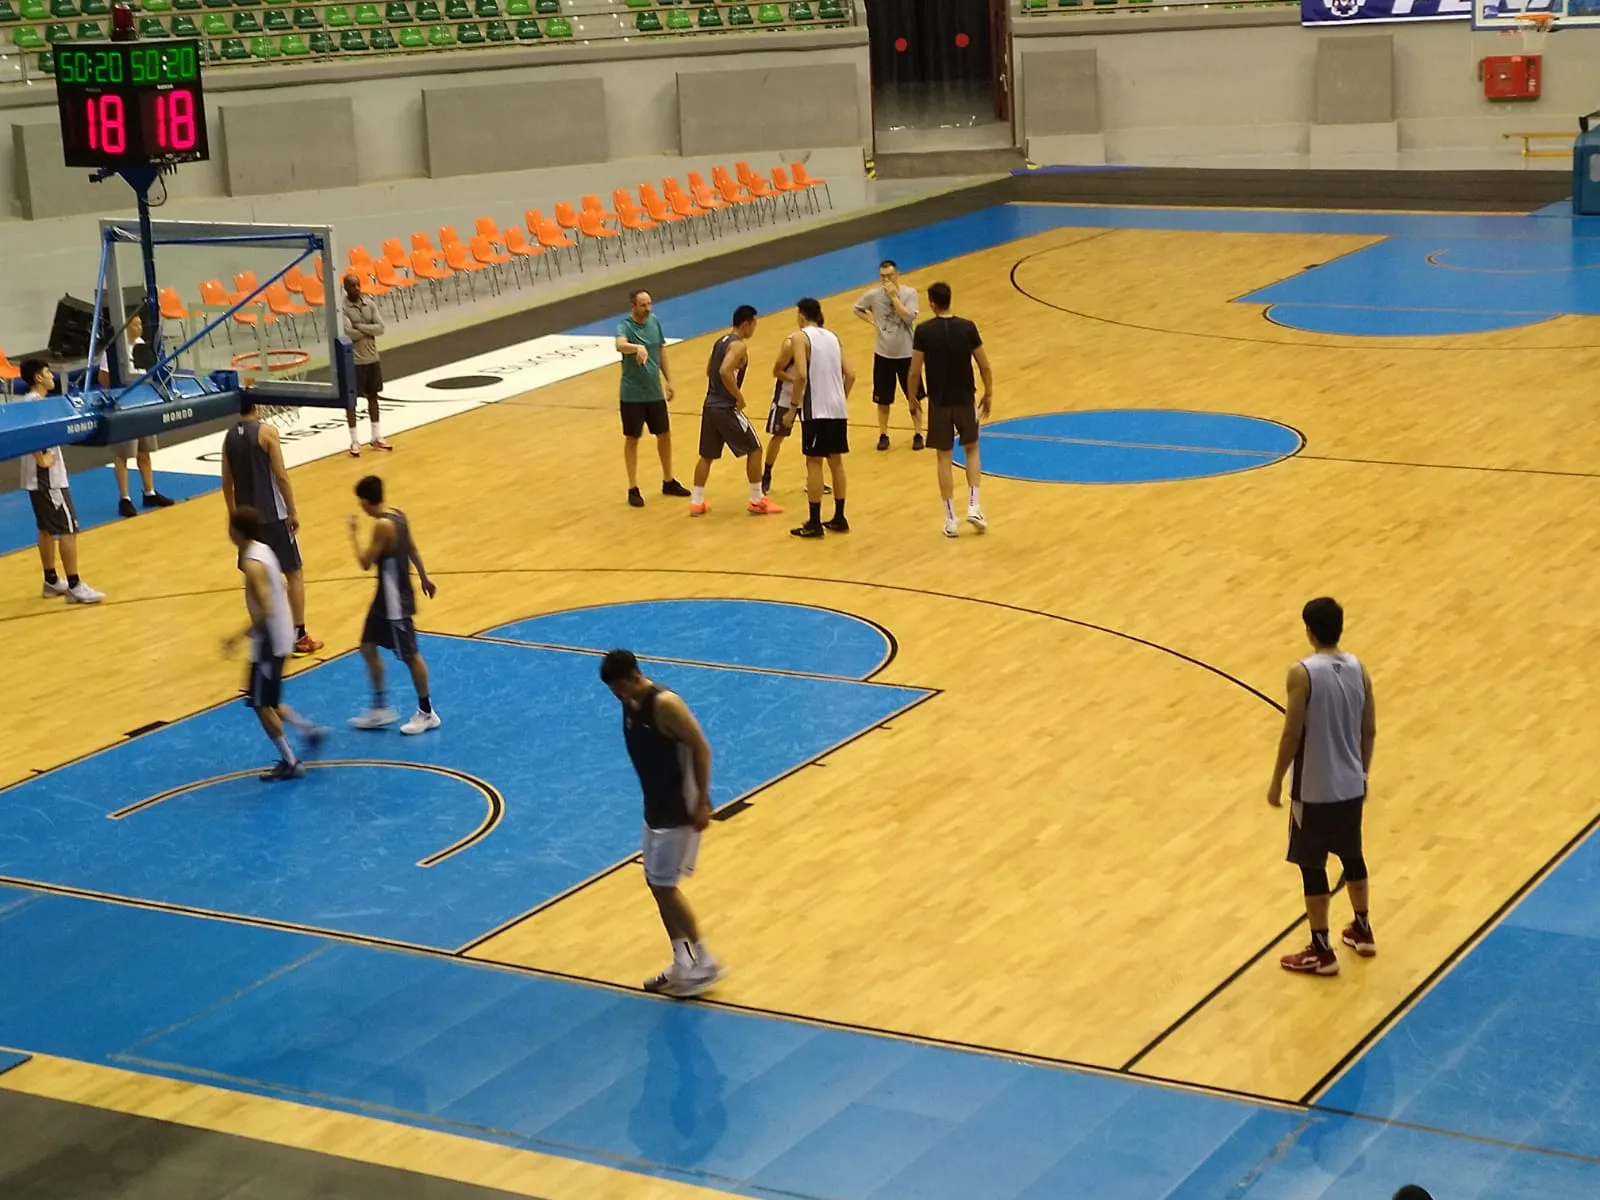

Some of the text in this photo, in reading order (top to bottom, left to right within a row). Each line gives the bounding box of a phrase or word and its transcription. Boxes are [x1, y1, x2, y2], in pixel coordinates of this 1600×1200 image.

[60, 52, 123, 83] 50:20
[130, 47, 195, 81] 50:20
[86, 94, 126, 154] 18
[156, 90, 196, 149] 18
[162, 408, 193, 424] MONDO
